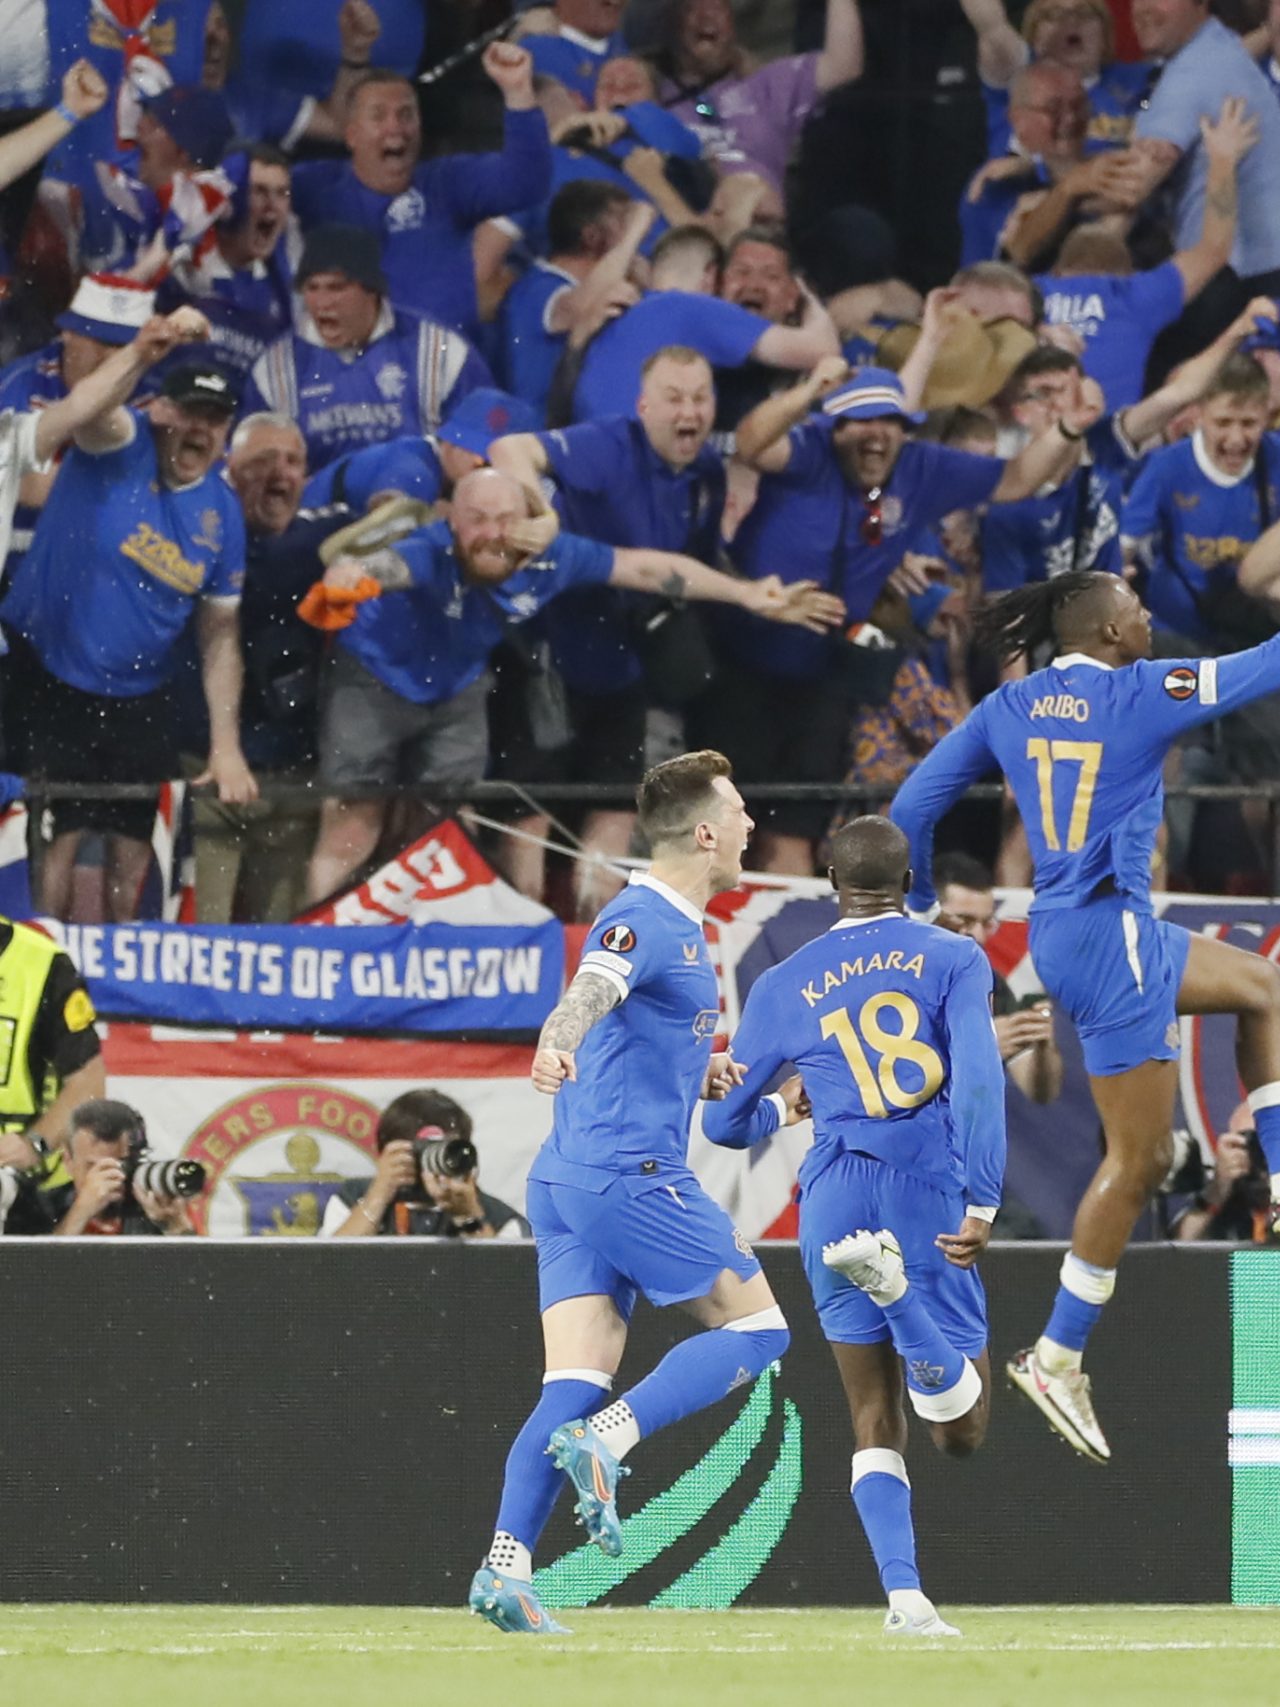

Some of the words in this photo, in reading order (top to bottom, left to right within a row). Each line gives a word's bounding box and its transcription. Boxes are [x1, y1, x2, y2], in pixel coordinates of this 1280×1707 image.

[1030, 693, 1090, 723] ARIBO
[1026, 737, 1103, 853] 17
[112, 928, 284, 997] STREETS
[291, 946, 344, 1000] OF
[350, 947, 542, 1000] GLASGOW
[801, 950, 925, 1008] KAMARA
[819, 991, 944, 1118] 18
